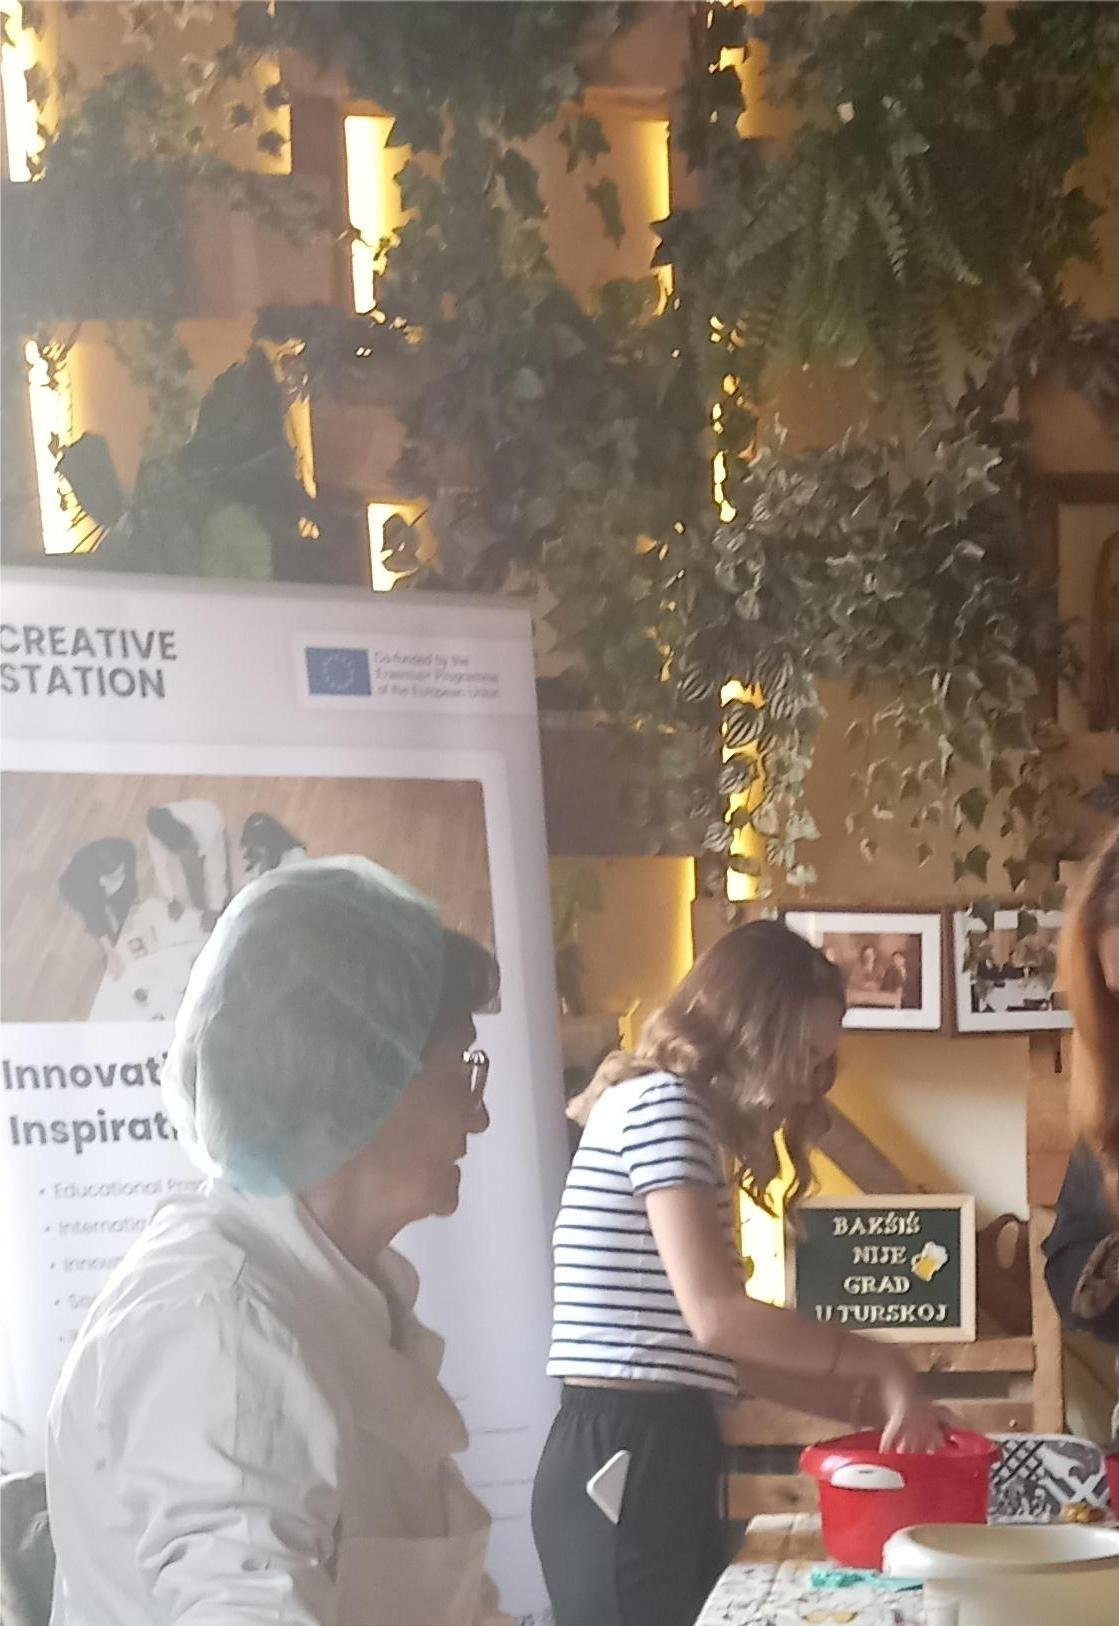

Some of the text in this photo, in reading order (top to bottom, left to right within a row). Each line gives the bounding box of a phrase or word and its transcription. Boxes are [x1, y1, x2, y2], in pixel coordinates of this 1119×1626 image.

[1, 623, 177, 661] CREATIVE
[1, 663, 166, 699] STATION
[2, 1052, 169, 1089] Innovat
[9, 1109, 178, 1154] Inspirat
[53, 1179, 163, 1199] Educational
[852, 1245, 907, 1265] NIJE
[843, 1275, 911, 1295] GRAD
[837, 1303, 949, 1323] TURSKOJ
